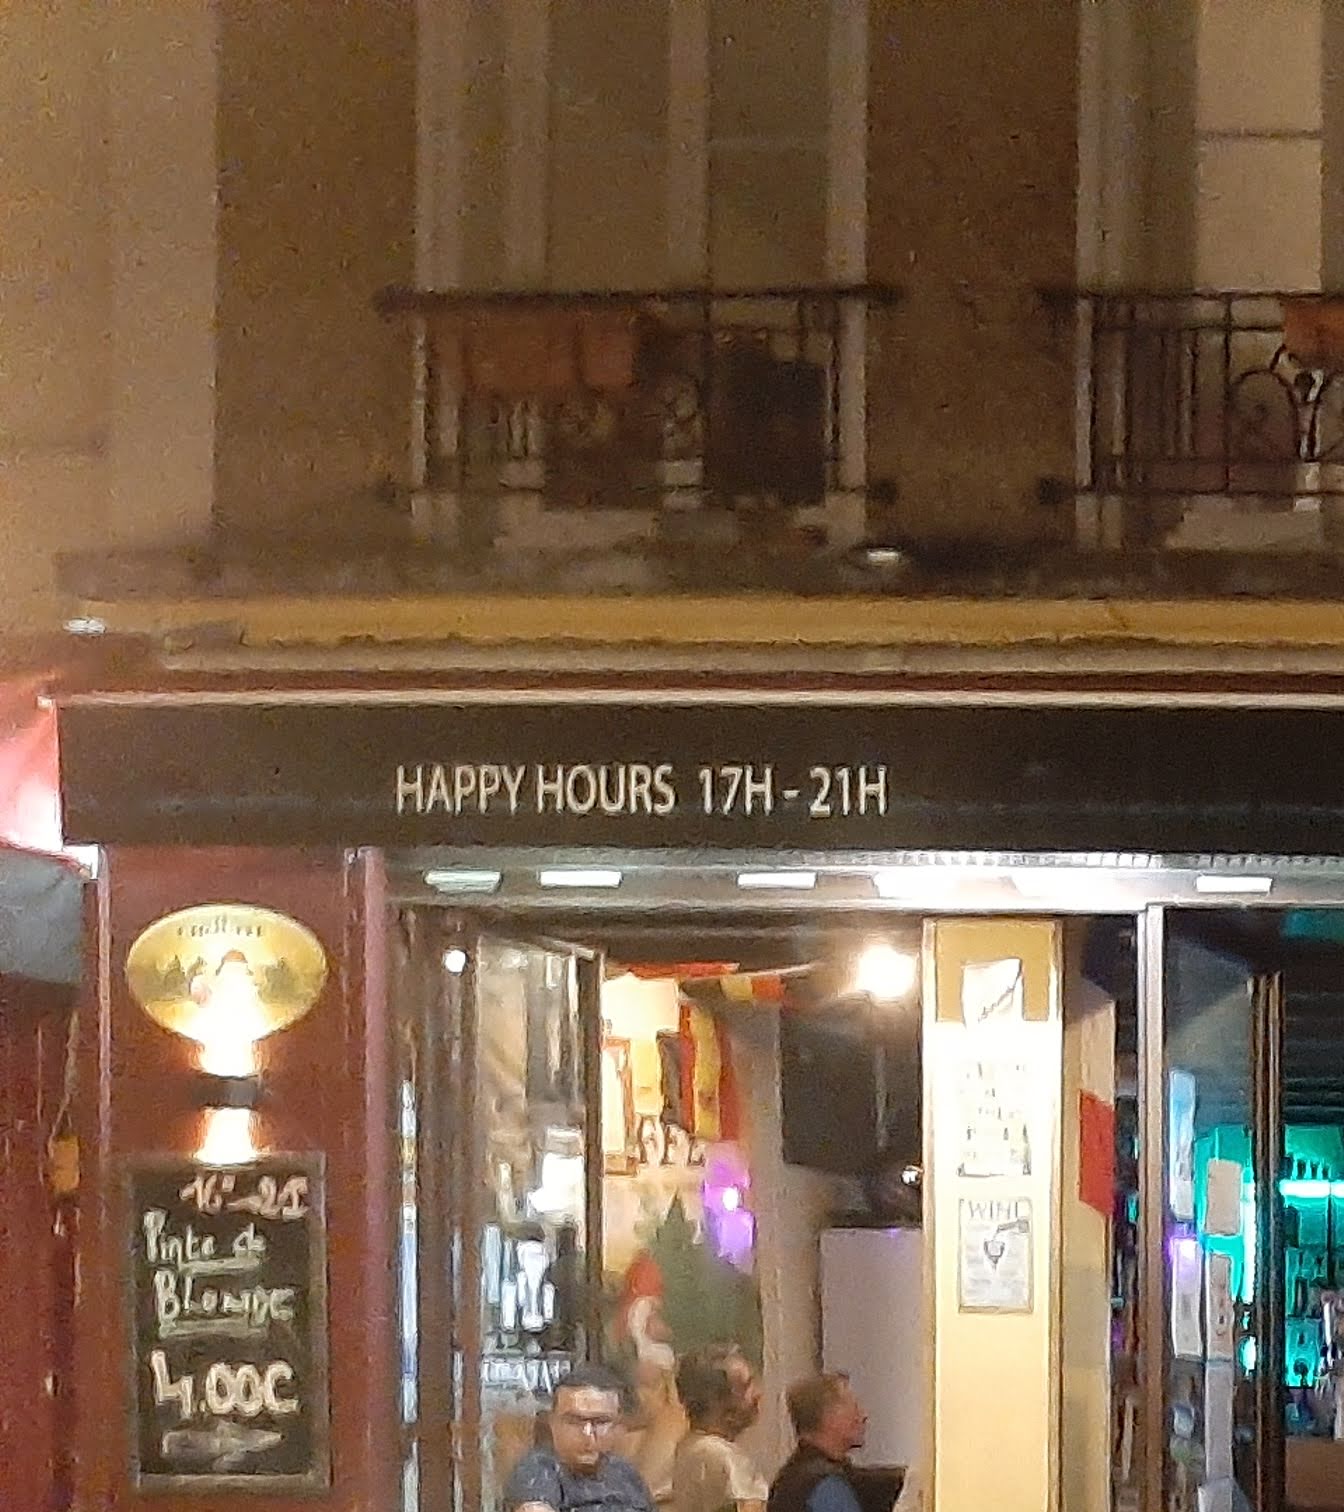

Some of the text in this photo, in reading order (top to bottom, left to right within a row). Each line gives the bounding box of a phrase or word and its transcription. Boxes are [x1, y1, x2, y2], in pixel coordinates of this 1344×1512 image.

[396, 764, 527, 816] HAPPY
[536, 764, 677, 816] HOURS
[700, 764, 774, 816] 17H
[809, 764, 888, 818] 21H
